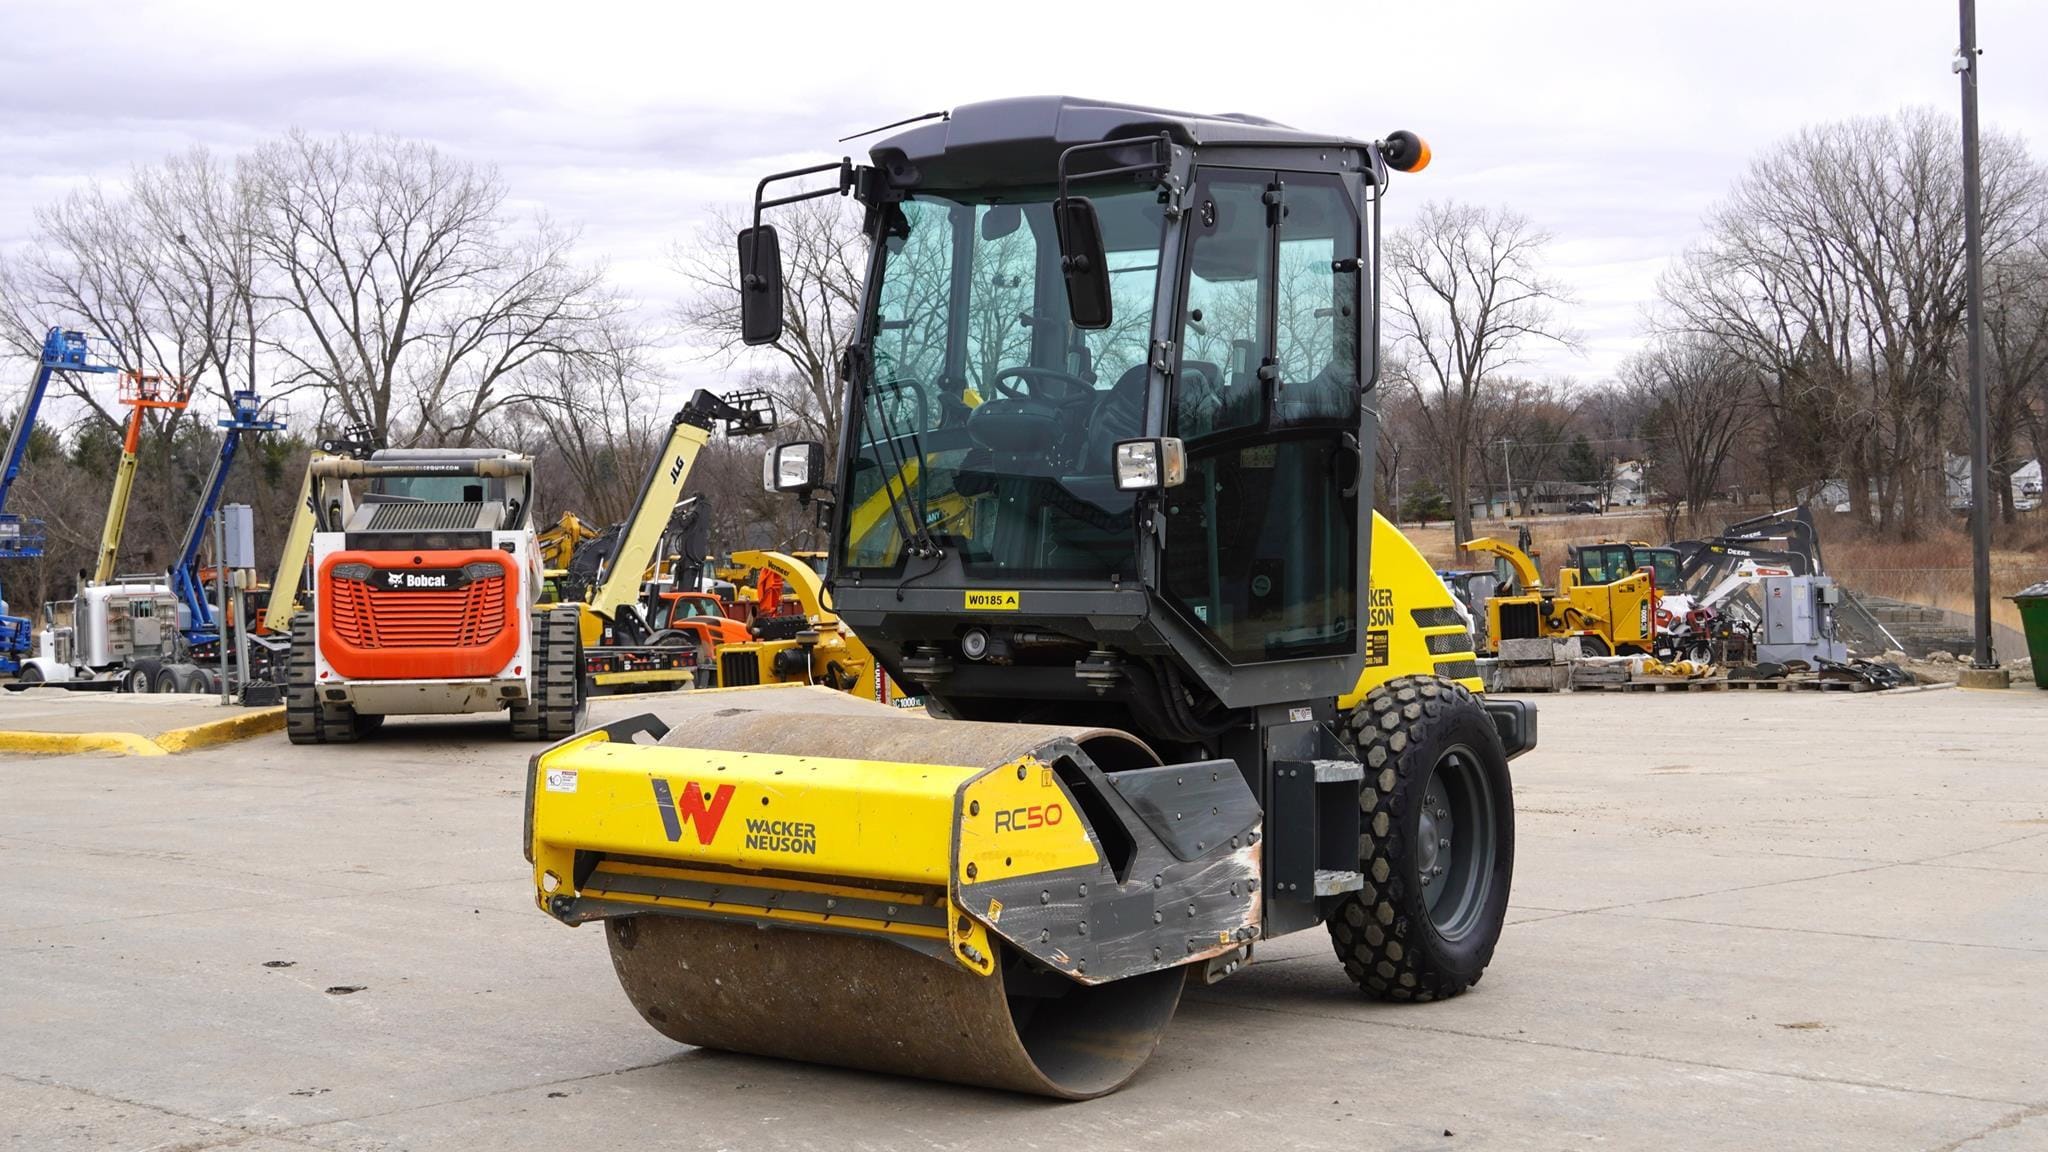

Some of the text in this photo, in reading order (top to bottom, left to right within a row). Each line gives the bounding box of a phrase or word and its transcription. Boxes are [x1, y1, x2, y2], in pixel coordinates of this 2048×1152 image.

[670, 455, 684, 485] JLG
[1727, 548, 1751, 557] DEERE
[406, 574, 446, 588] Bobcat
[969, 595, 1016, 605] W0185 A
[1370, 588, 1393, 607] KER
[1370, 607, 1394, 626] SON
[995, 803, 1063, 834] RC50
[745, 818, 816, 839] WACKER
[745, 834, 816, 855] NEUSON
